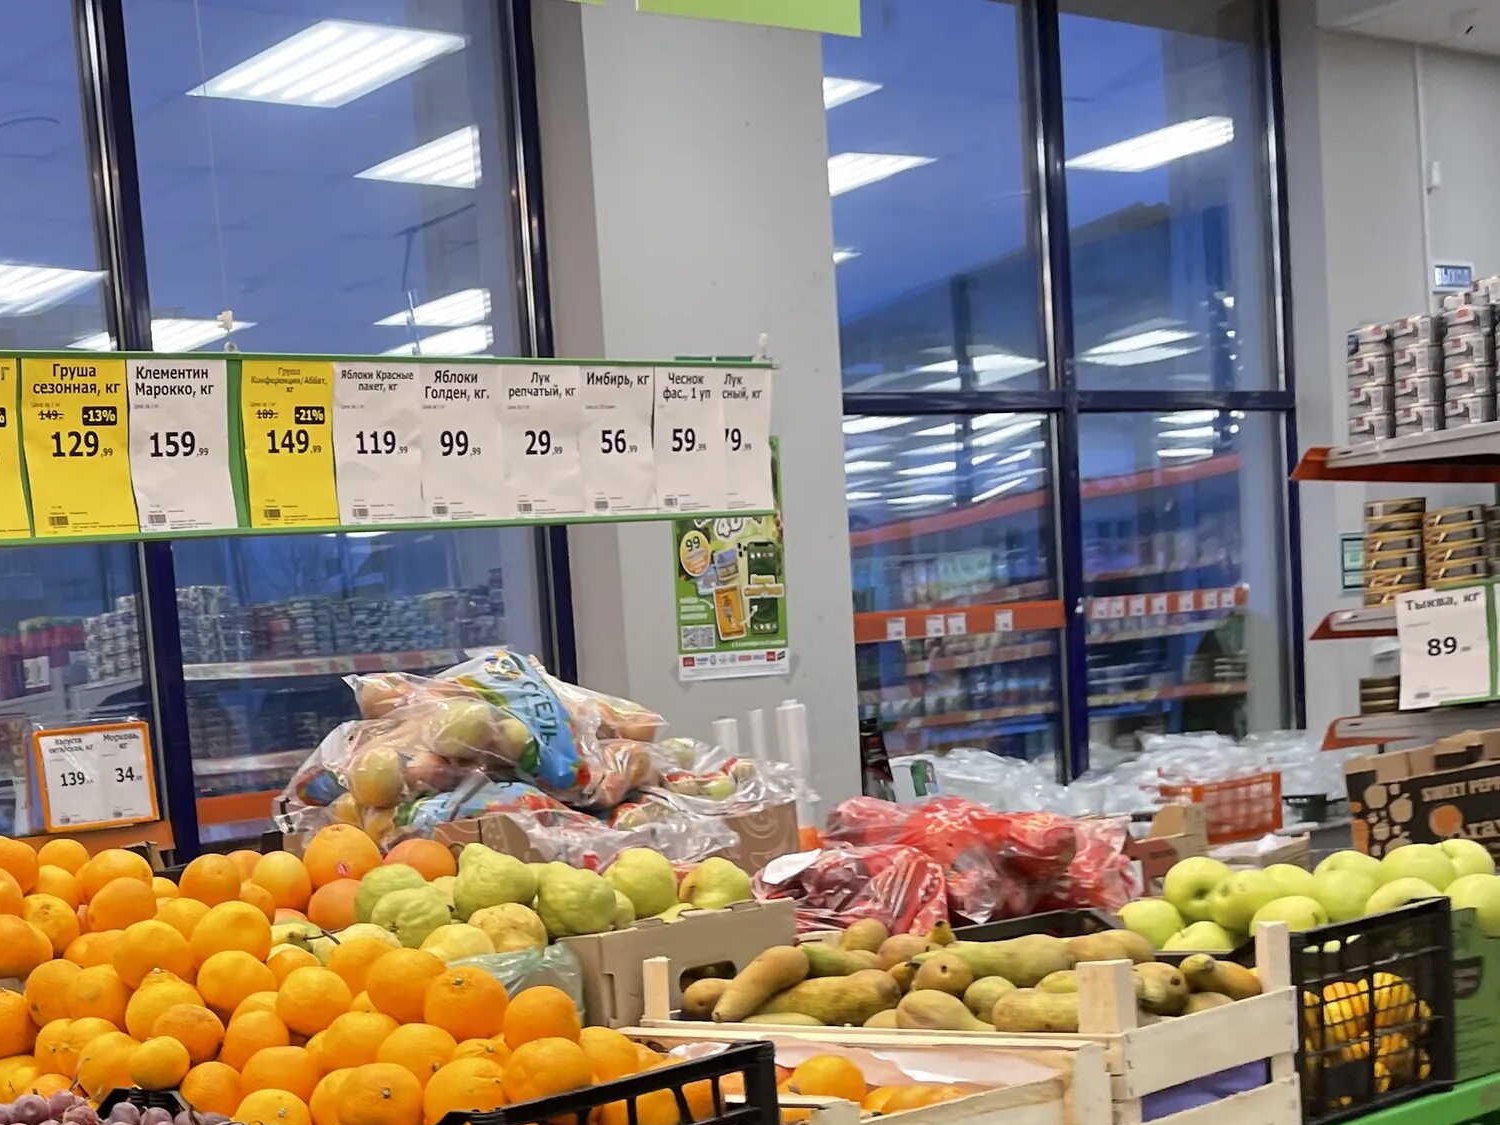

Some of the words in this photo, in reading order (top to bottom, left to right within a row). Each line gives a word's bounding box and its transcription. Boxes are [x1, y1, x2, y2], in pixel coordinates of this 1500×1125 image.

[52, 363, 96, 383] Груша
[136, 366, 209, 380] Клементин
[340, 369, 373, 381] Яблоки
[376, 370, 414, 382] Красные
[434, 370, 478, 384] Яблоки
[531, 372, 550, 385] Лук
[586, 372, 633, 387] Имбирь,
[637, 374, 650, 386] кг
[668, 372, 704, 385] Чеснок
[724, 373, 742, 386] Лук
[33, 382, 101, 396] сезонная,
[106, 383, 121, 394] кг
[135, 383, 196, 398] Марокко,
[200, 384, 214, 395] кг
[286, 386, 294, 394] кг
[358, 382, 386, 392] пакет,
[389, 382, 398, 391] кг
[424, 386, 471, 401] Голден,
[508, 386, 562, 399] репчатый,
[565, 387, 576, 397] кг
[752, 388, 763, 399] кг
[83, 409, 116, 422] -13%
[295, 409, 324, 422] -21%
